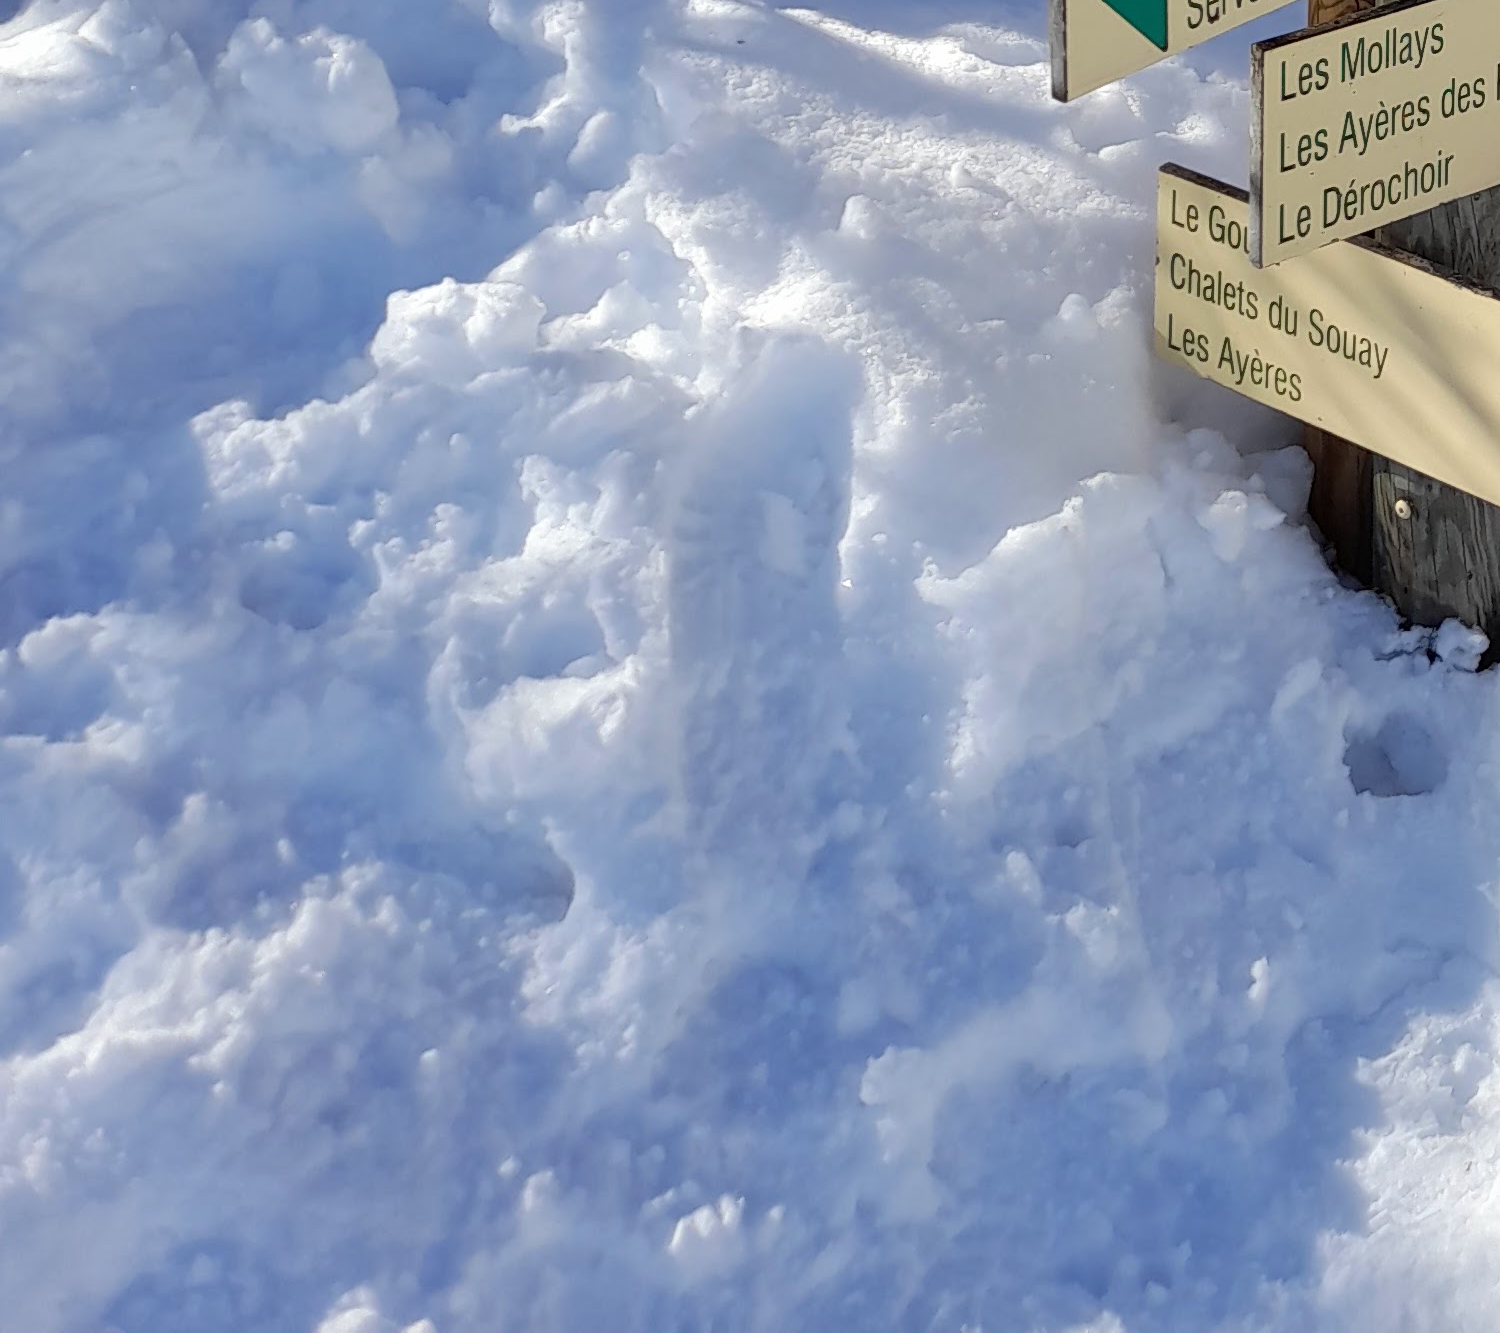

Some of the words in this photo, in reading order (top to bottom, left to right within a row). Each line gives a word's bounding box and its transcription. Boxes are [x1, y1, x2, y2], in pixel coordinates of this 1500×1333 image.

[1281, 58, 1329, 101] Les
[1341, 23, 1443, 82] Mollays
[1281, 129, 1328, 172] Les
[1339, 96, 1430, 155] Ayères
[1442, 78, 1485, 118] des
[1172, 190, 1198, 232] Le
[1279, 204, 1311, 245] Le
[1323, 149, 1454, 228] Dérochoir
[1168, 313, 1209, 363] Les
[1217, 337, 1302, 403] Ayères
[1169, 253, 1259, 321] Chalets
[1269, 296, 1297, 336] du
[1309, 309, 1388, 379] Souay
